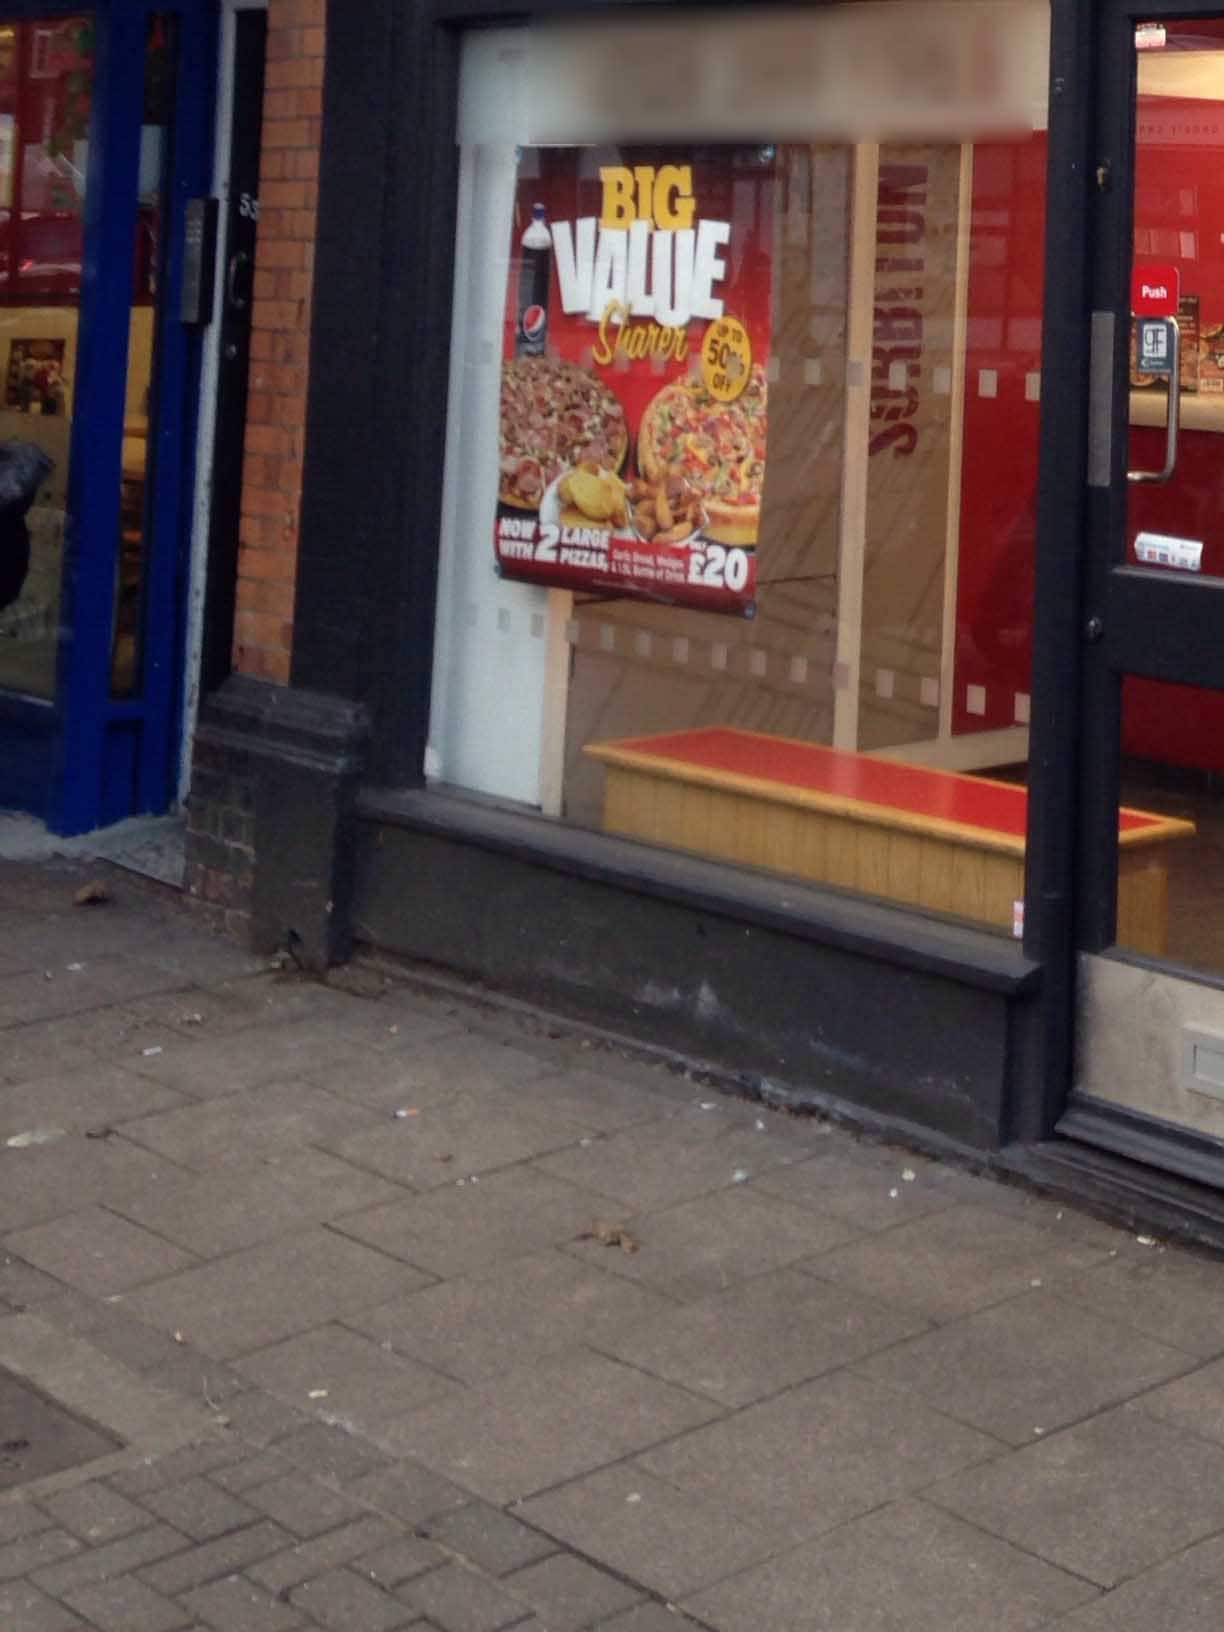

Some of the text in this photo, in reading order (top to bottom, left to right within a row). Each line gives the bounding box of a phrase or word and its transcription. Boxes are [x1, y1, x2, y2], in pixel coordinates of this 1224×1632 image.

[599, 165, 696, 232] BIG
[551, 216, 730, 327] VALUE
[1142, 285, 1167, 299] Push
[499, 517, 536, 540] NOW
[535, 524, 560, 563] 2
[688, 545, 748, 593] £20
